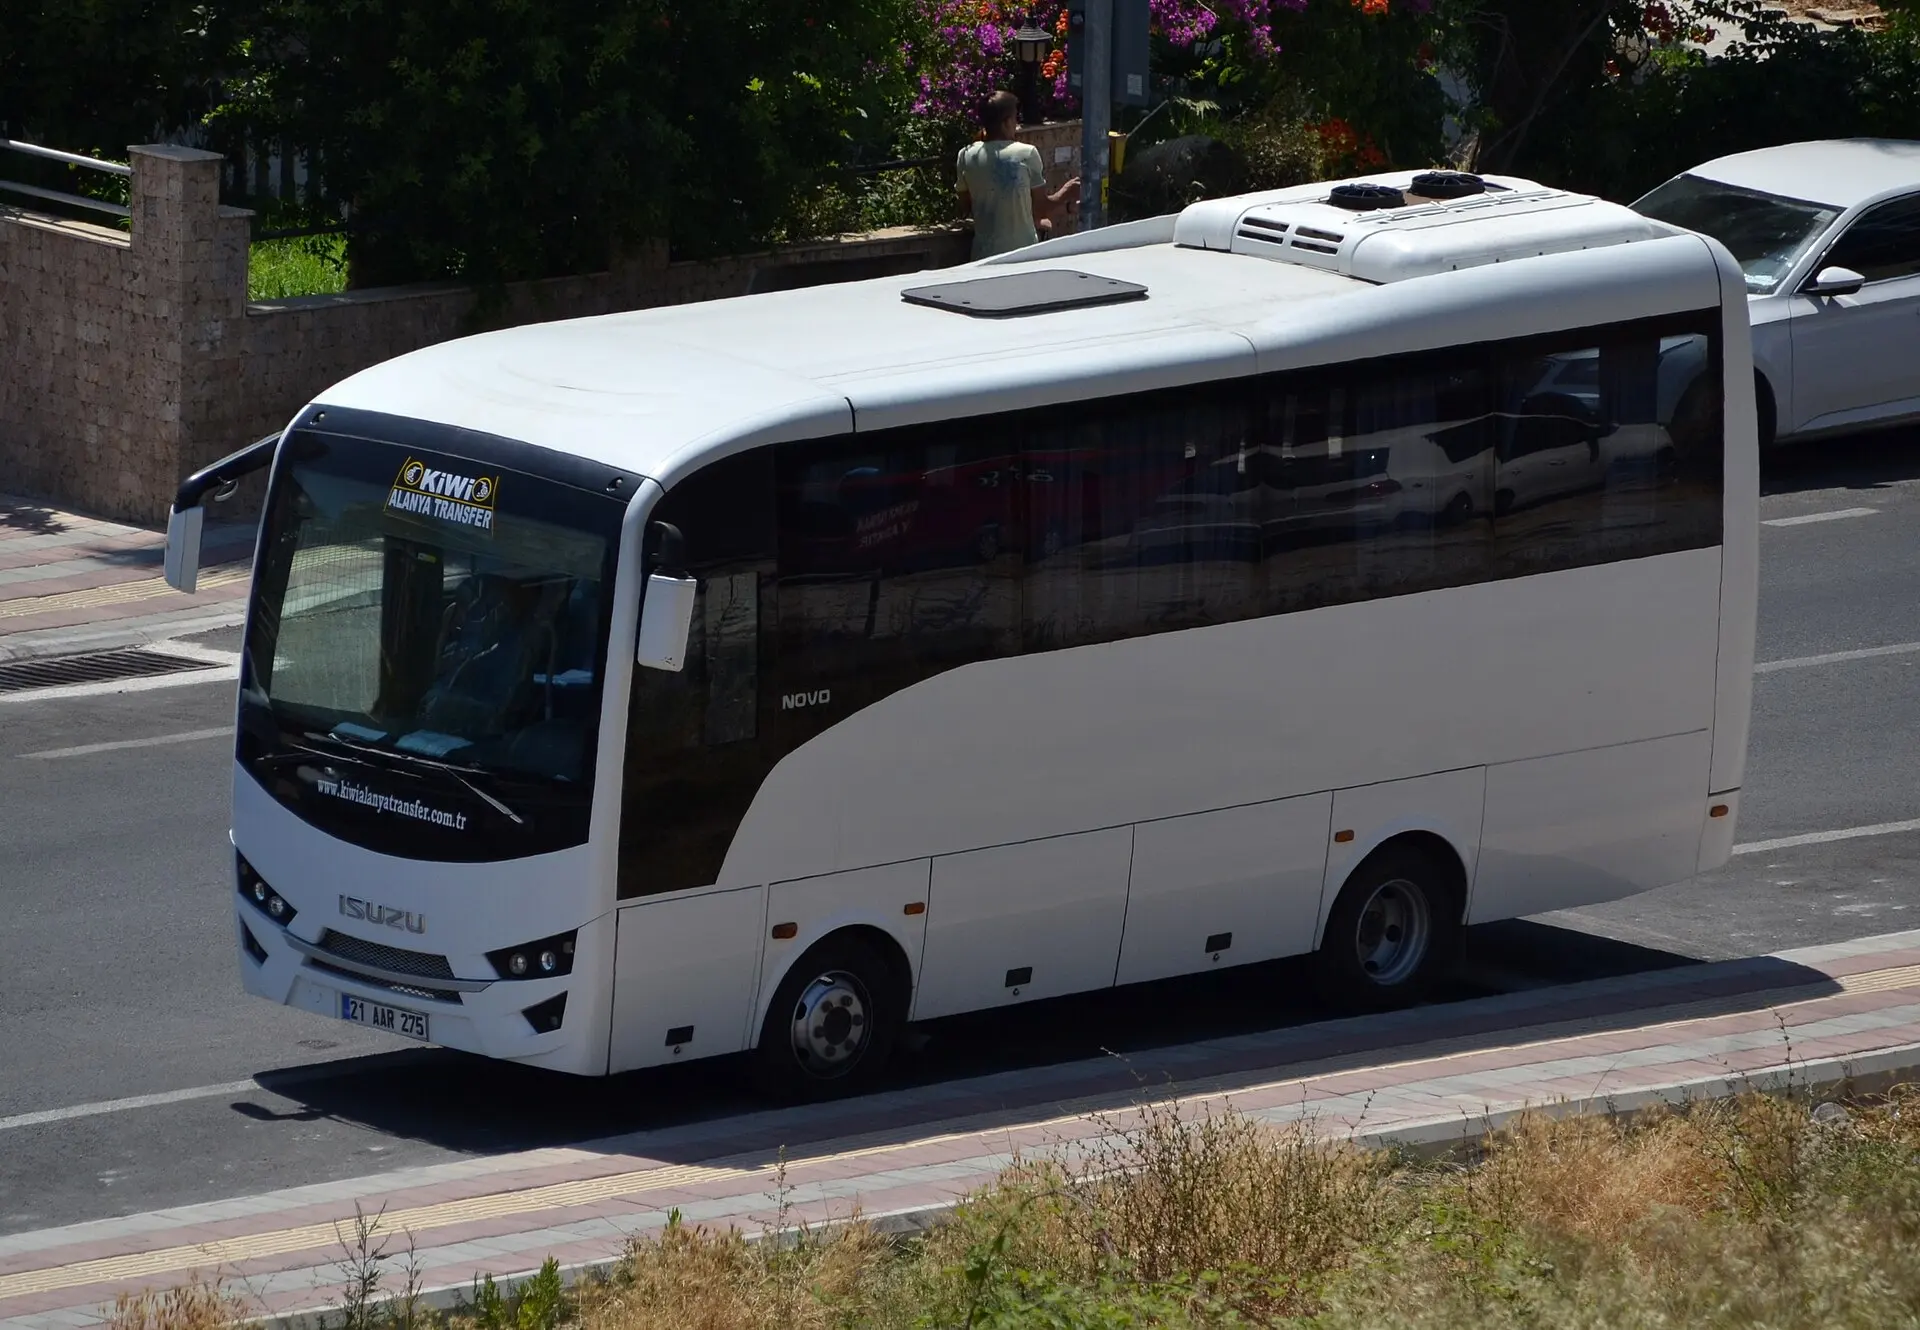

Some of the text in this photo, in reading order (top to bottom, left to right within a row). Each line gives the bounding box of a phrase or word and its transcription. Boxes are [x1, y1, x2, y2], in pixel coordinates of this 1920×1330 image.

[388, 489, 492, 529] ALANYA TRANSFER
[782, 689, 830, 710] NOVO
[317, 779, 467, 830] www.kiwialanyatransfer.com.tr
[338, 894, 427, 935] ISUZU
[350, 1000, 424, 1036] 21 AAR 275
